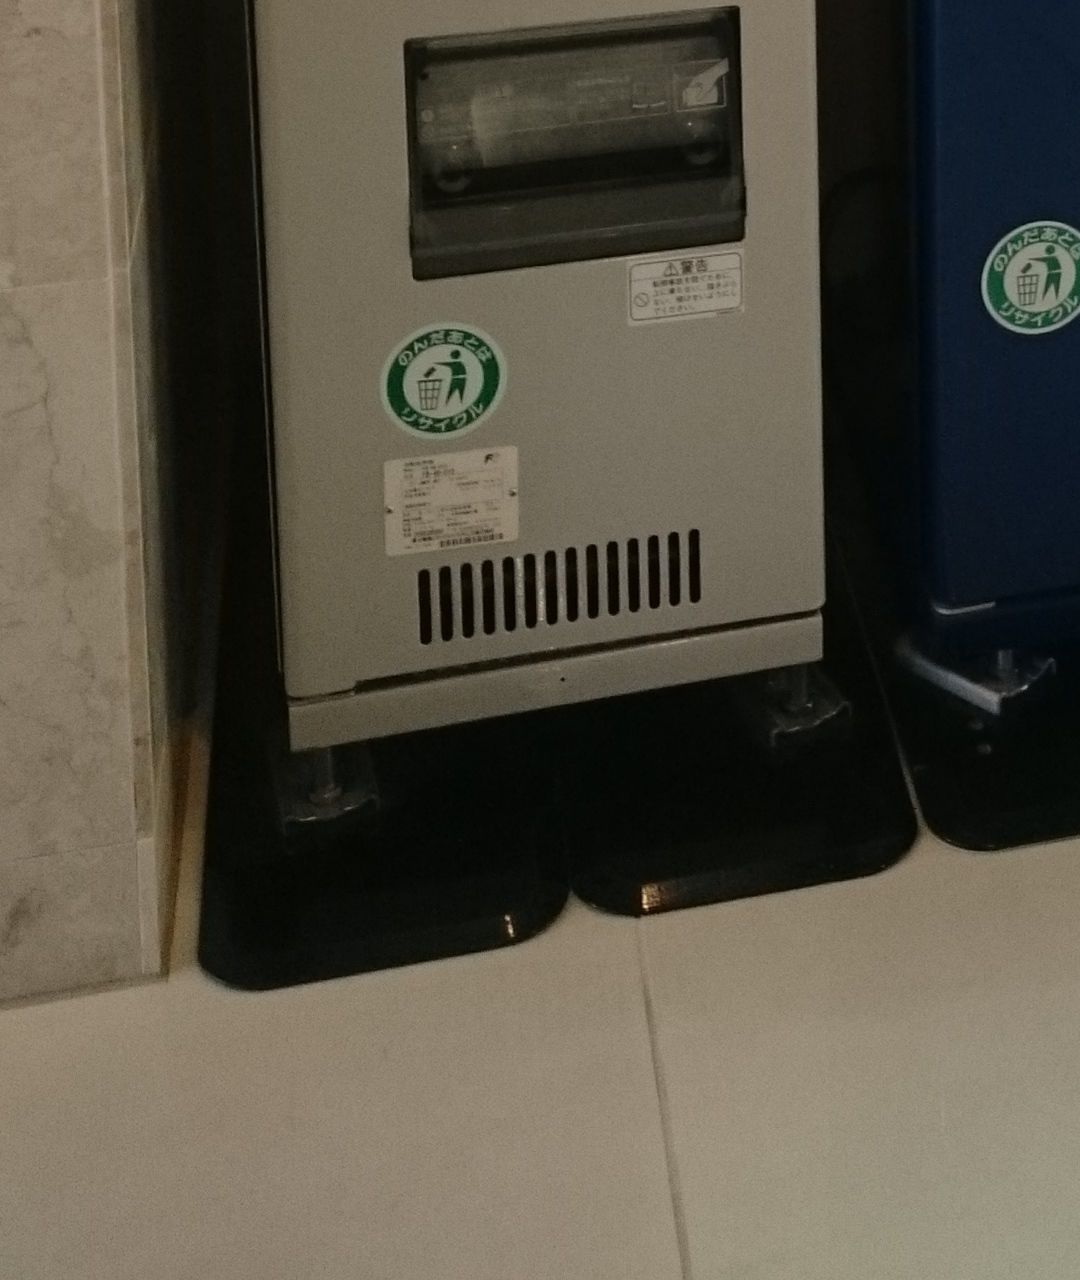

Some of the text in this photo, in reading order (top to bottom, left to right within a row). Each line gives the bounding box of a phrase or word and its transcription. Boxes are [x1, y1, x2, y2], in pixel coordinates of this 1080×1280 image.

[999, 295, 1078, 327] リサイクル
[399, 329, 492, 367] のんだあとは
[401, 400, 484, 432] リサイクル
